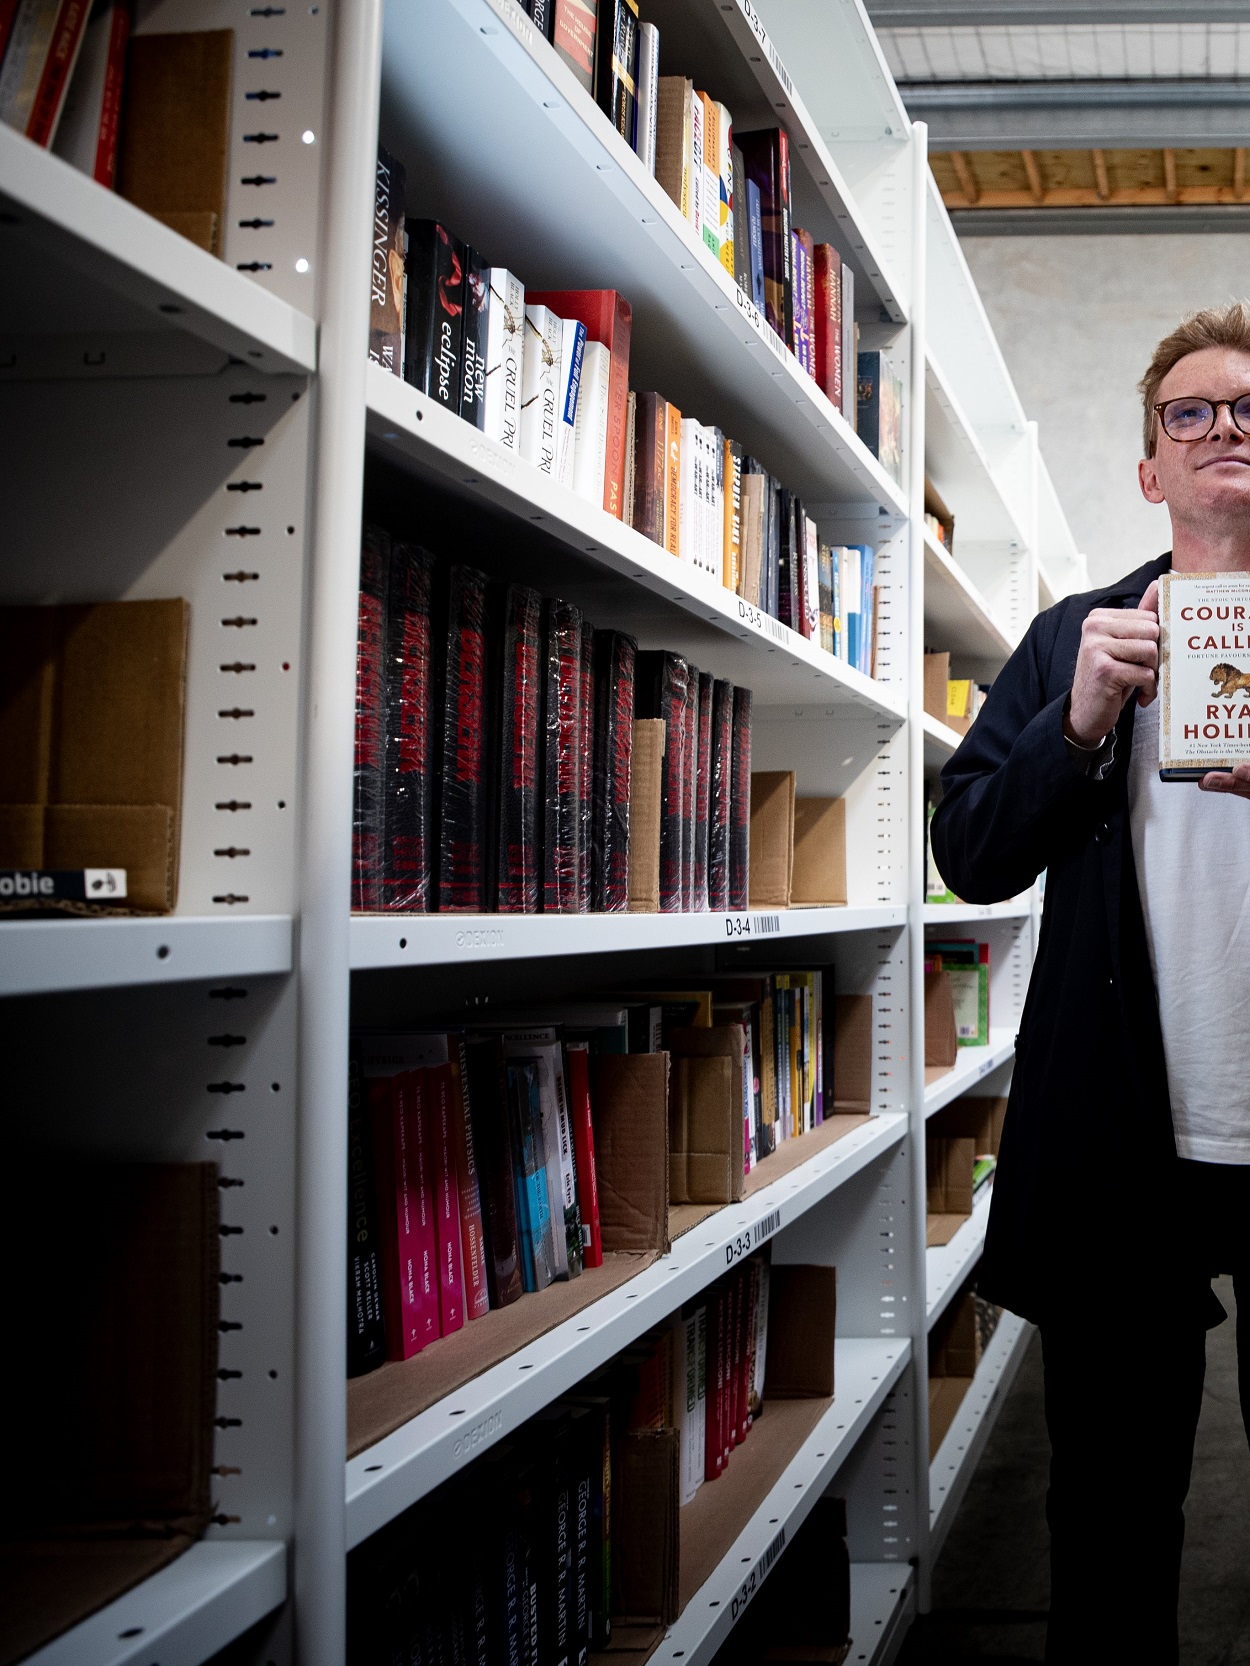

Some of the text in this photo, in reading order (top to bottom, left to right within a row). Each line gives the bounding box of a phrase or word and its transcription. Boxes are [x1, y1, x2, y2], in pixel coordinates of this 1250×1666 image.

[745, 0, 766, 43] D-3-7
[372, 159, 390, 307] KISSINGER
[736, 288, 760, 328] D-3-6
[438, 322, 452, 400] eclipse
[463, 336, 476, 404] moon
[474, 353, 485, 404] new
[834, 346, 842, 397] WOMEN
[504, 356, 518, 420] CRUEL
[540, 388, 554, 449] CRUEL
[670, 467, 678, 514] DEMOCRACY
[733, 456, 741, 509] STEPHEN
[732, 514, 740, 545] KING
[738, 602, 762, 628] D-3-5
[1232, 622, 1244, 632] IS
[726, 918, 750, 936] D-3-4
[459, 1039, 476, 1176] EXISTENTIAL PHYSICS
[350, 1116, 368, 1244] Excellence
[468, 1224, 480, 1288] HOSSENFELDER
[726, 1232, 751, 1264] D-3-3
[356, 1290, 364, 1335] MALHOTRA
[686, 1321, 696, 1413] TRANSFORMED
[697, 1310, 707, 1400] TRANSFORMED
[557, 1493, 568, 1647] GEORGE MARTIN
[577, 1480, 588, 1631] GEORGE MARTIN
[732, 1572, 756, 1620] D-3-2
